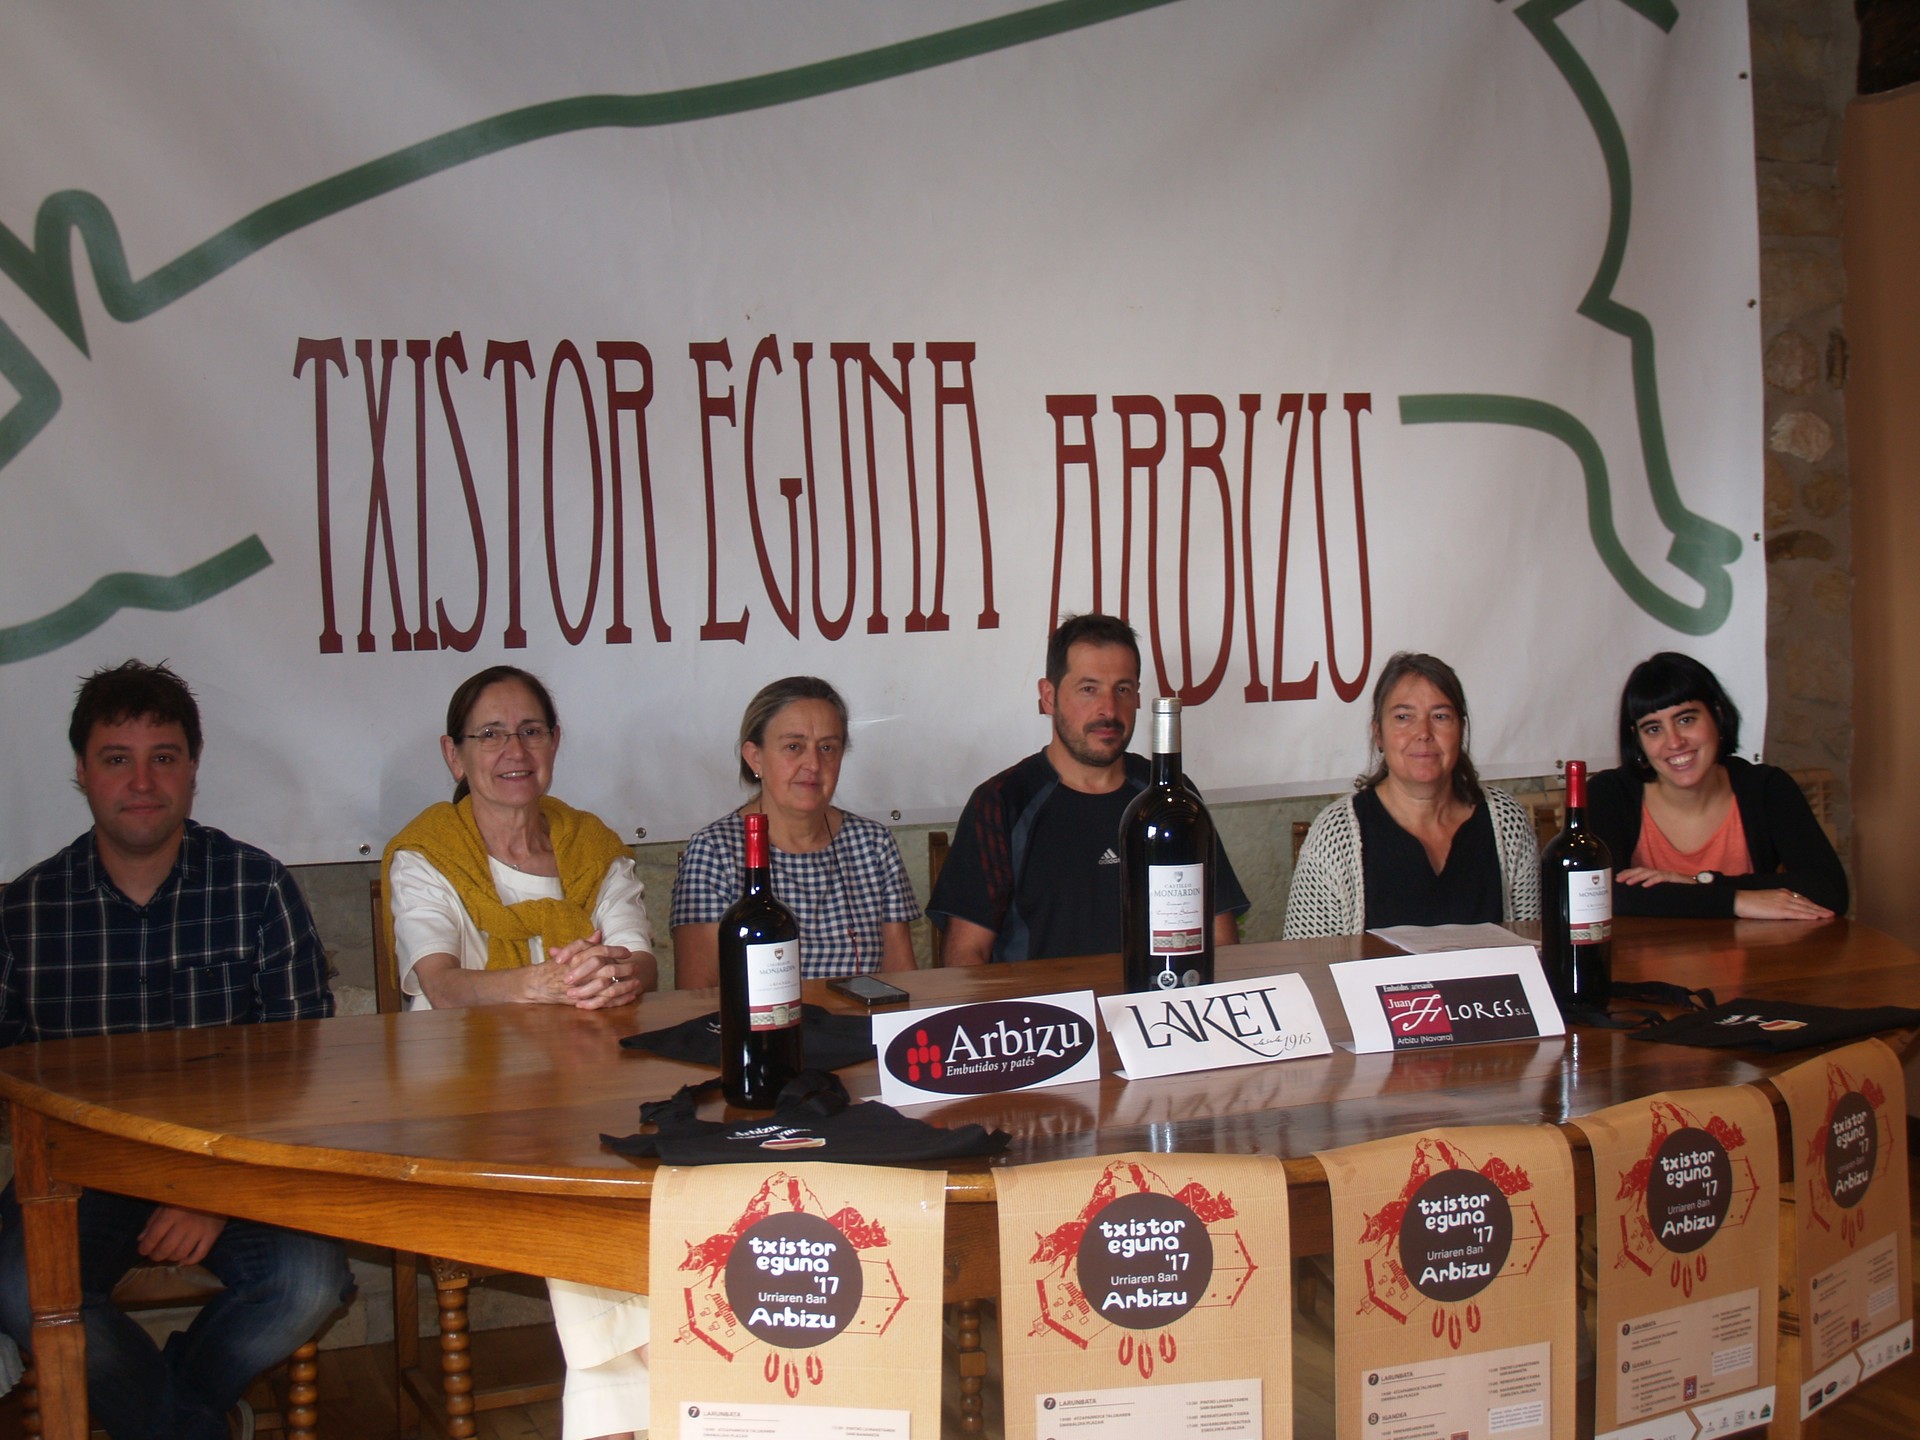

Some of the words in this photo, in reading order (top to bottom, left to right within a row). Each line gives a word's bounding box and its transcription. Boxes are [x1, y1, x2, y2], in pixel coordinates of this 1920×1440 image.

[292, 331, 671, 654] TXISTOR
[689, 334, 1000, 645] EGUNA
[1038, 392, 1373, 715] ARBIZU
[1153, 887, 1201, 897] MONJARDIN
[1388, 999, 1411, 1009] Juan
[1125, 987, 1284, 1057] LAKET
[945, 1017, 1083, 1063] Arbizu
[1284, 1032, 1312, 1051] 1915
[1397, 1036, 1420, 1045] Arbizu
[1421, 1033, 1454, 1043] (Navarra)
[946, 1062, 999, 1077] Embutidos
[1000, 1060, 1008, 1072] y
[1010, 1055, 1035, 1070] patés
[1833, 1111, 1867, 1135] txistor
[1660, 1151, 1715, 1171] txistor
[1666, 1165, 1712, 1188] eguna
[1834, 1170, 1869, 1196] Arbizu
[1702, 1180, 1718, 1196] '17
[1418, 1194, 1490, 1215] txistor
[1099, 1219, 1186, 1238] txistor
[1425, 1210, 1485, 1233] eguna
[1661, 1215, 1716, 1238] Arbizu
[1473, 1226, 1494, 1243] '17
[749, 1237, 836, 1257] txistor
[1107, 1236, 1179, 1258] eguna
[1427, 1247, 1464, 1261] Urriaren
[1466, 1245, 1484, 1255] 8an
[756, 1256, 829, 1276] eguna
[1165, 1253, 1190, 1271] '17
[1110, 1274, 1155, 1286] Urriaren
[1157, 1272, 1178, 1283] 8an
[1419, 1262, 1490, 1285] Arbizu
[814, 1276, 840, 1294] '17
[758, 1292, 803, 1304] Urriaren
[806, 1293, 827, 1305] 8an
[1101, 1288, 1188, 1310] Arbizu
[748, 1307, 836, 1328] Arbizu
